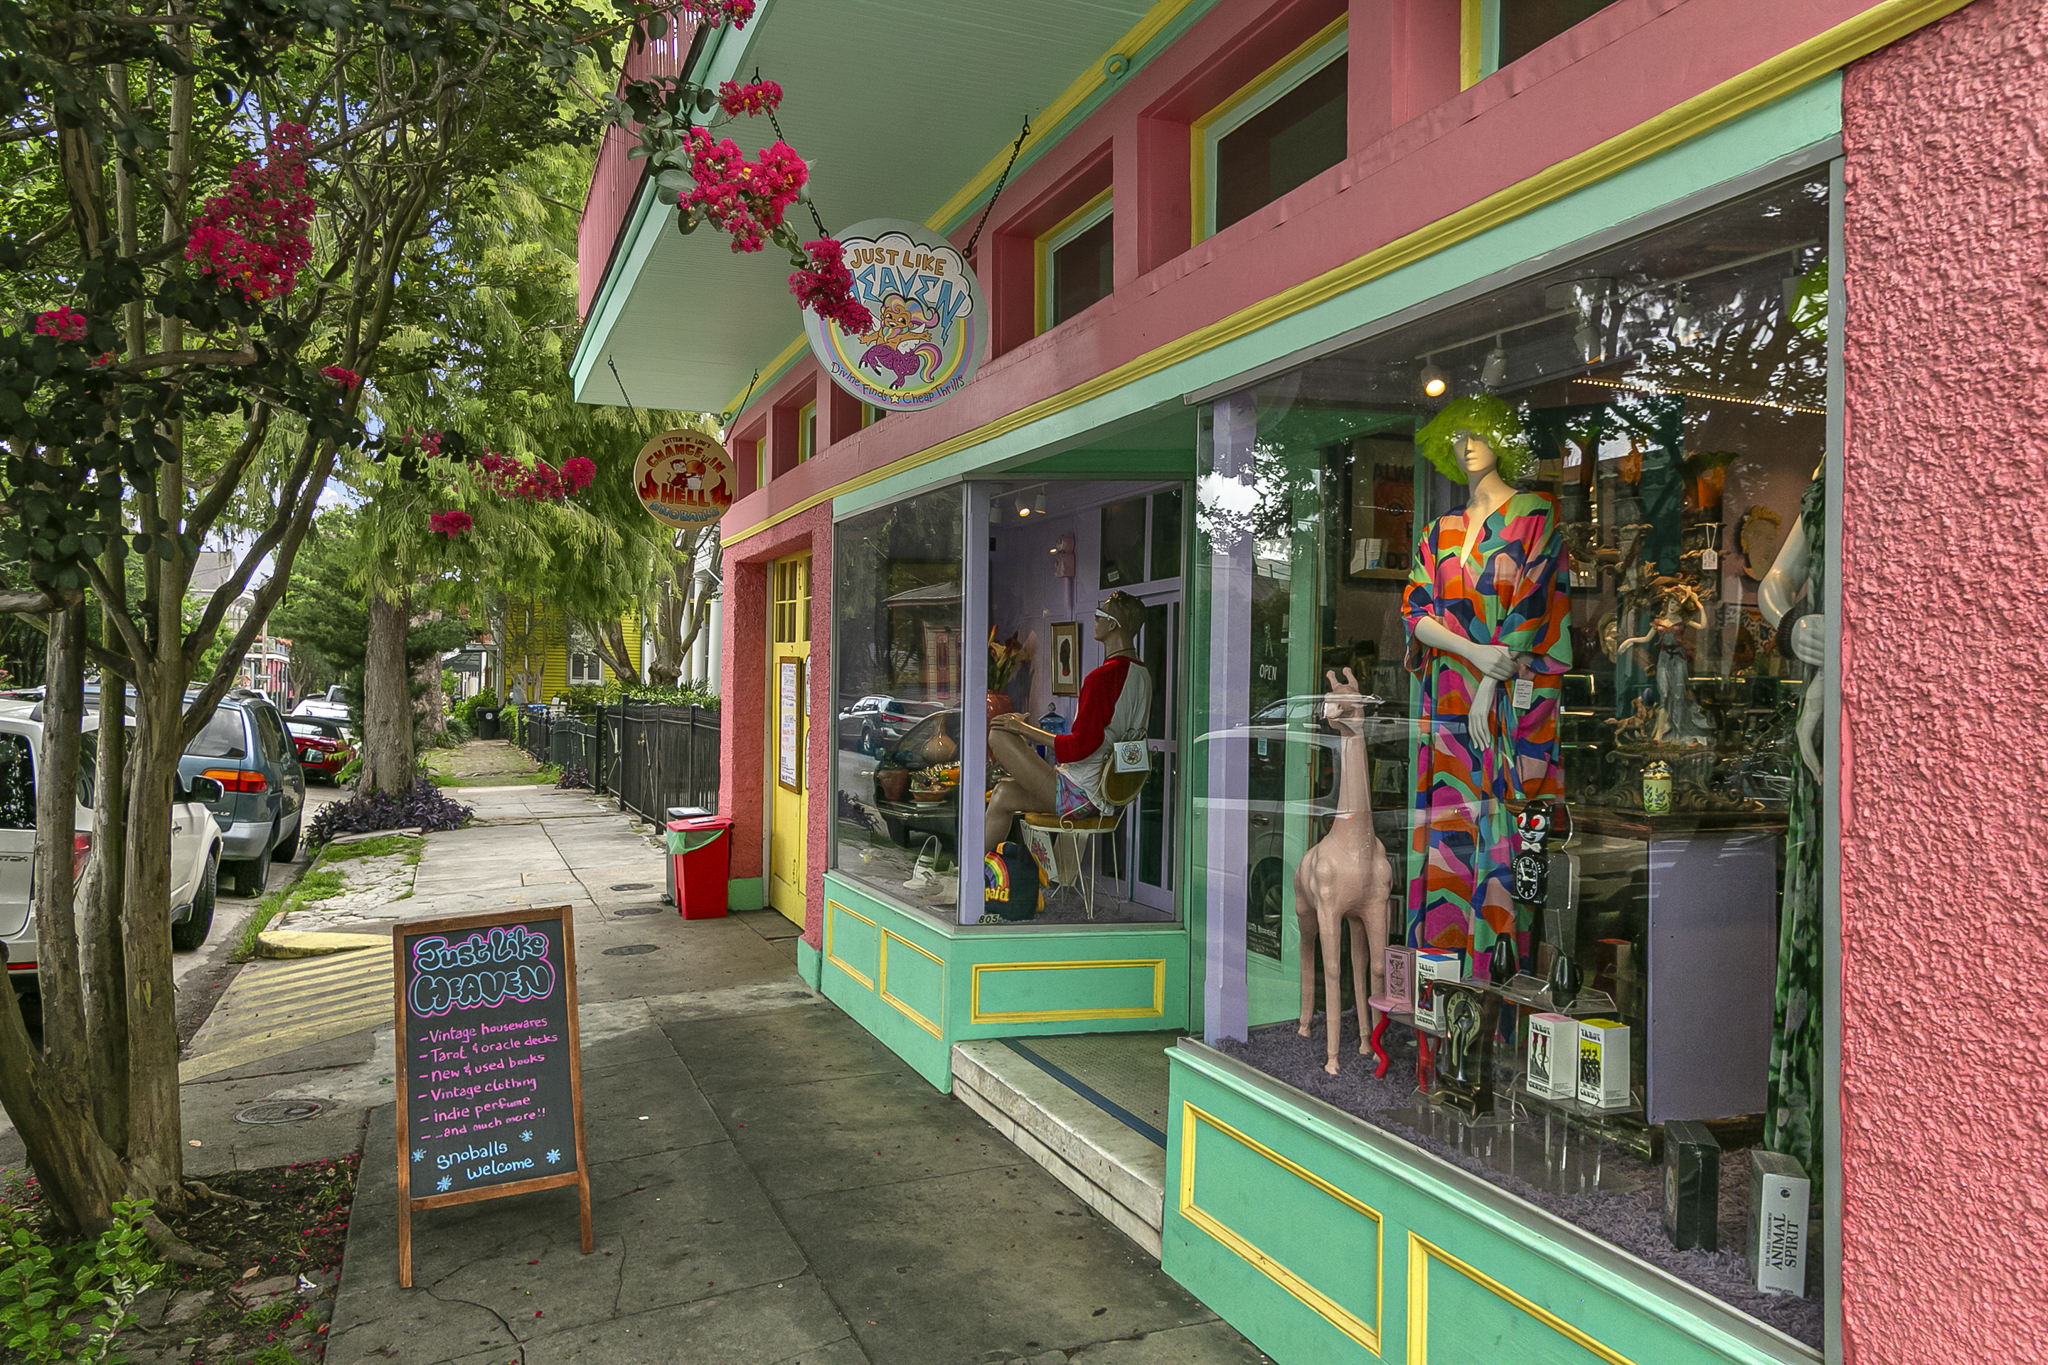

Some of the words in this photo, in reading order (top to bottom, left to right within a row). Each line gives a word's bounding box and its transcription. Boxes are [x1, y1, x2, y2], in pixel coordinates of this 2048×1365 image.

[850, 248, 899, 268] JUST
[902, 250, 946, 276] LIKE
[831, 361, 860, 387] Divine
[862, 383, 887, 401] Finds
[902, 392, 934, 404] Cheap
[931, 375, 965, 397] Thrills
[646, 443, 704, 467] CHANCE
[709, 456, 726, 473] IN
[661, 482, 710, 507] HELL
[649, 501, 720, 522] SNOBALLS
[1259, 663, 1278, 681] OPEN
[978, 914, 999, 924] 805
[415, 935, 491, 971] Just
[489, 928, 547, 963] Like
[414, 964, 551, 1012] HEAVEN
[429, 1027, 477, 1043] Vintage
[481, 1017, 548, 1035] housewares
[1530, 1021, 1551, 1035] TAROT
[1580, 1028, 1601, 1042] TAROT
[430, 1046, 468, 1063] Tarot
[481, 1038, 521, 1053] oracle
[524, 1033, 558, 1046] decks
[475, 1059, 505, 1073] used
[508, 1054, 545, 1068] books
[430, 1085, 482, 1101] Vintage
[484, 1077, 537, 1092] clothing
[433, 1106, 470, 1123] indie
[475, 1096, 531, 1119] perfume
[472, 1117, 503, 1132] much
[466, 1156, 535, 1181] welcome
[1771, 1212, 1786, 1271] ANIMAL
[1785, 1220, 1799, 1269] SPIRIT
